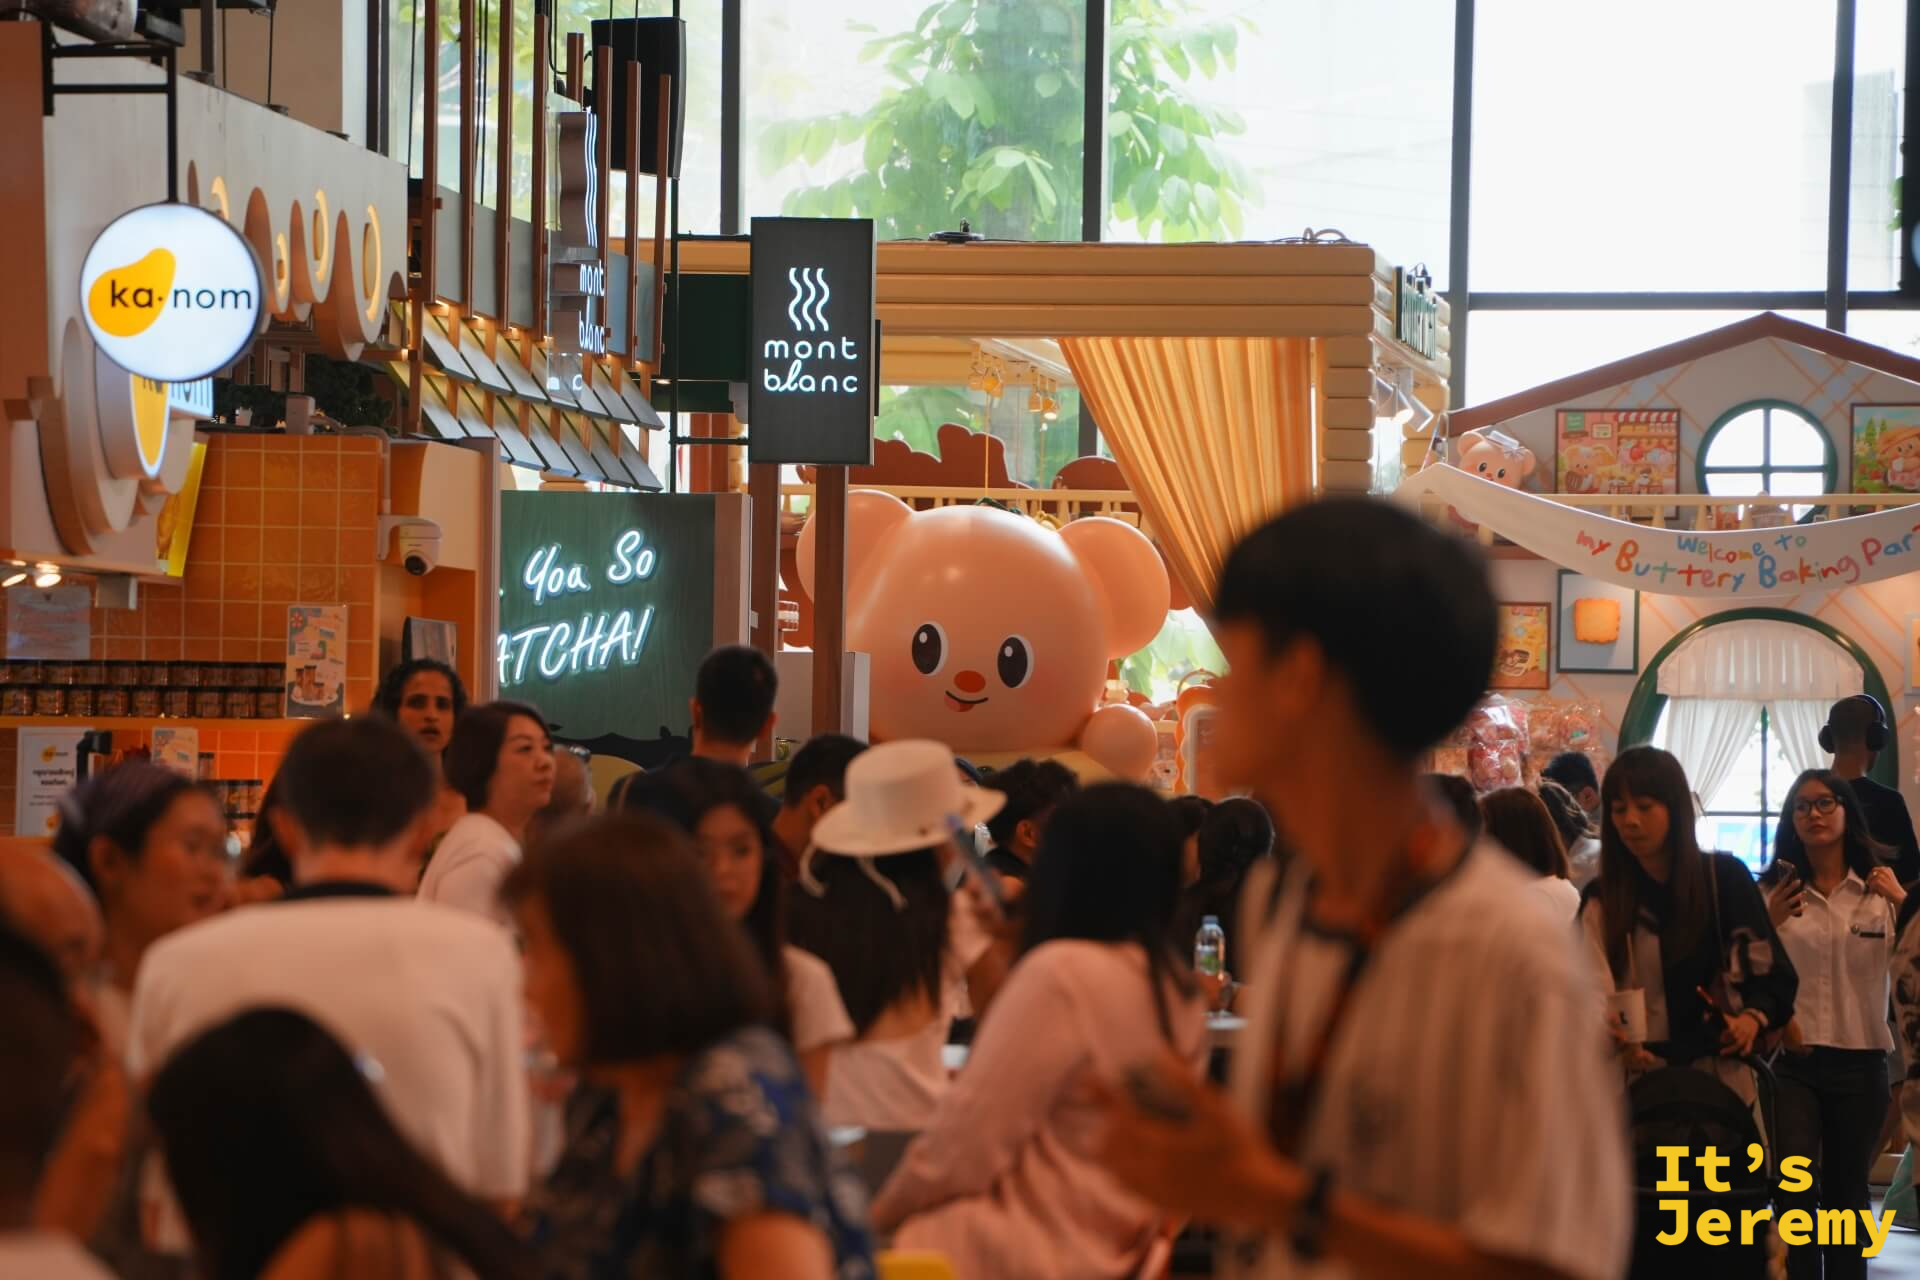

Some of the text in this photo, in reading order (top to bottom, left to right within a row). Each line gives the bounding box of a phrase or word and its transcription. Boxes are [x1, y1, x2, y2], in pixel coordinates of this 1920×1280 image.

[580, 258, 605, 297] mont
[579, 296, 605, 354] blanc
[764, 336, 858, 362] mont
[763, 359, 858, 393] blanc
[607, 529, 655, 583] So
[1615, 539, 1745, 592] Buttery
[1759, 554, 1861, 589] Baking
[1861, 523, 1920, 567] Par
[1677, 534, 1807, 563] Welcome to
